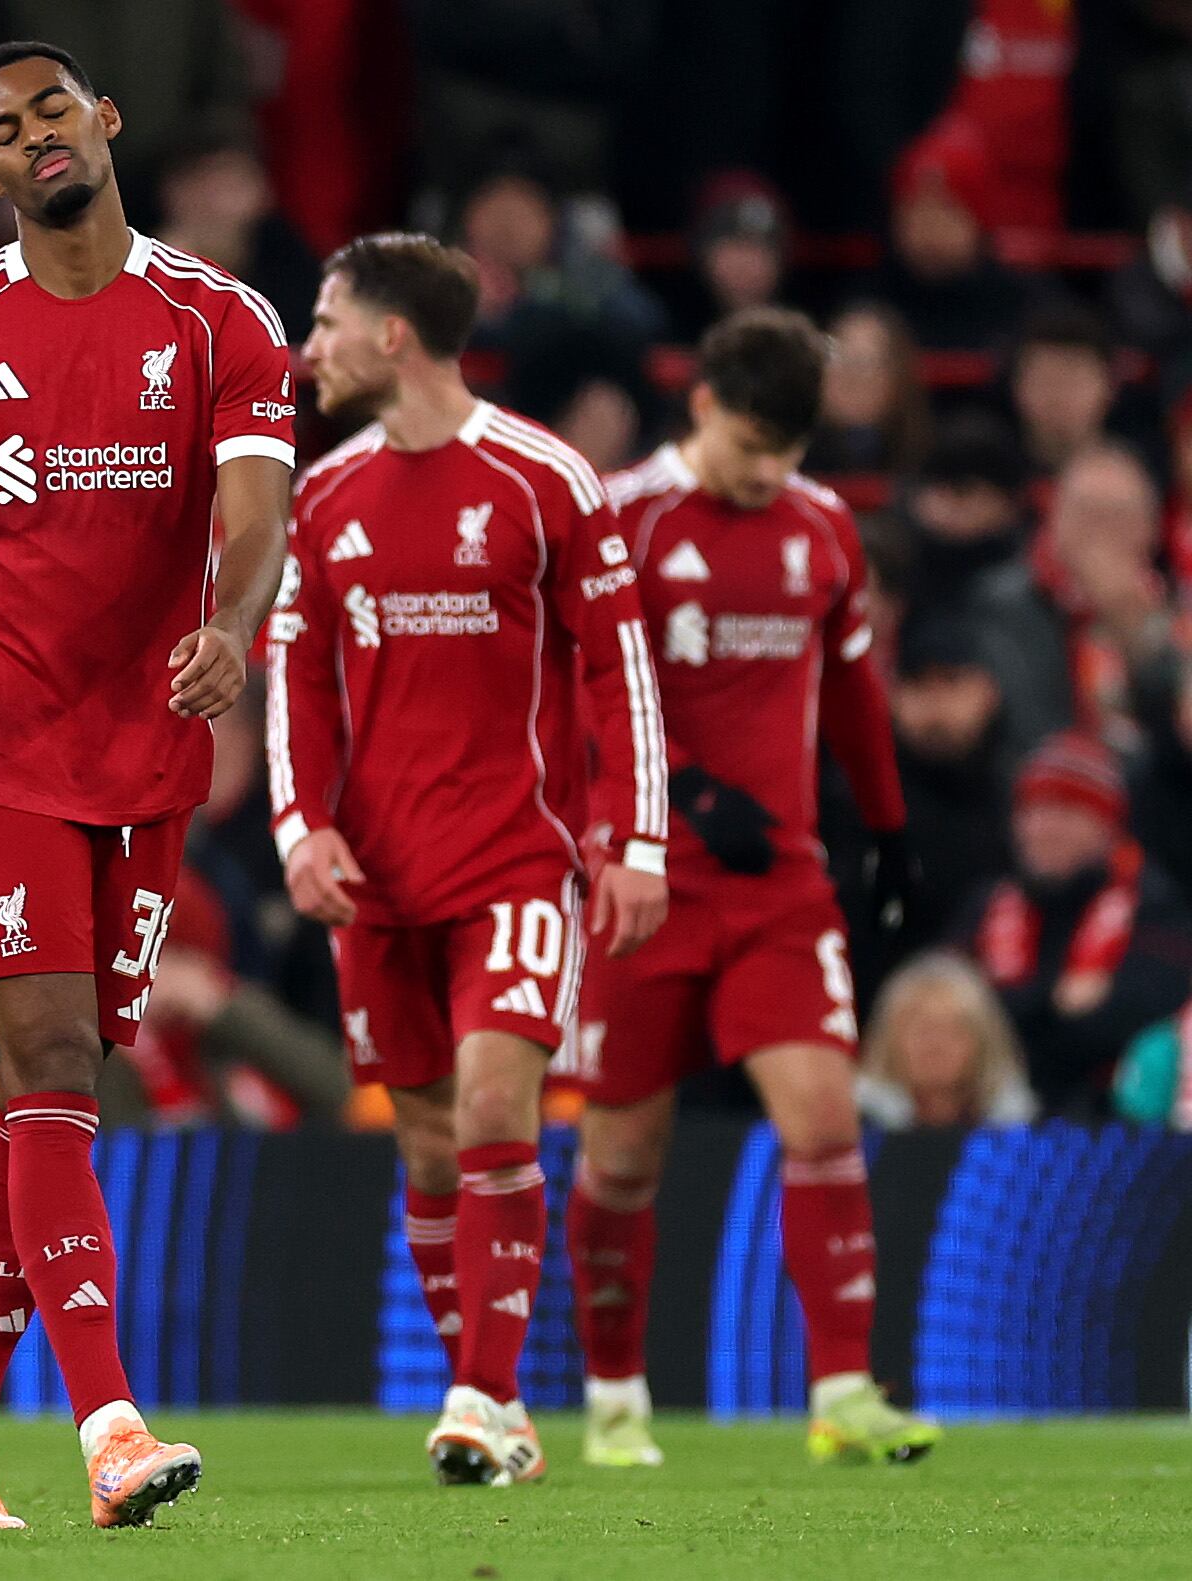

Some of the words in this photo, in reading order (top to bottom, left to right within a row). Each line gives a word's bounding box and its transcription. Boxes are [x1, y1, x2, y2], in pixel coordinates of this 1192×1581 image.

[45, 442, 166, 467] standard
[46, 466, 172, 491] chartered
[380, 590, 489, 614] standard
[382, 610, 499, 636] chartered
[485, 899, 562, 976] 10
[43, 1235, 100, 1262] LFC
